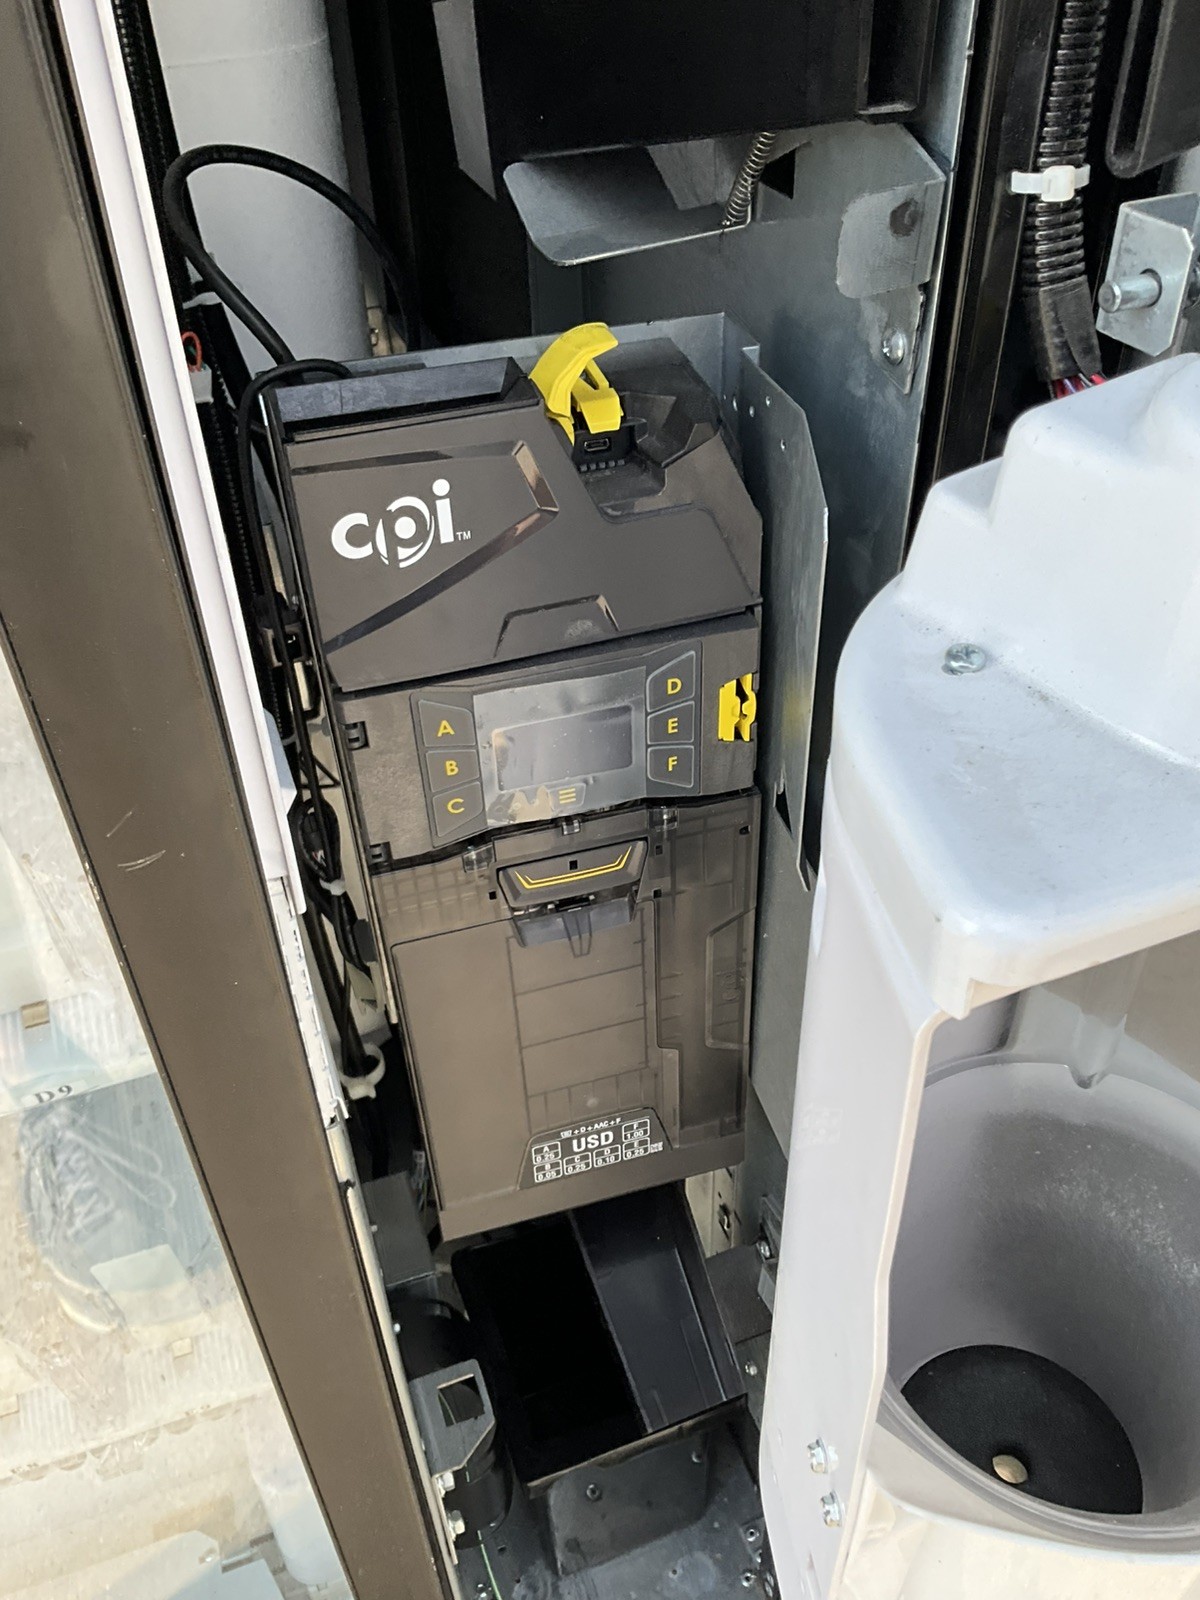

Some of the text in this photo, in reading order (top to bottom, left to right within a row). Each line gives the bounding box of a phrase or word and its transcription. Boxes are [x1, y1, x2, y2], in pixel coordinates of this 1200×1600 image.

[331, 478, 455, 569] cpi
[667, 677, 682, 695] D
[437, 720, 455, 737] A
[667, 717, 679, 734] E
[445, 759, 459, 777] B
[667, 755, 679, 772] F
[446, 798, 465, 814] C
[572, 1131, 614, 1152] USD
[626, 1130, 643, 1139] 1.00
[536, 1153, 555, 1162] 0.25
[597, 1156, 615, 1165] 0.10
[626, 1148, 644, 1158] 0.25
[538, 1171, 556, 1180] 0.05
[567, 1164, 586, 1173] 0.25
